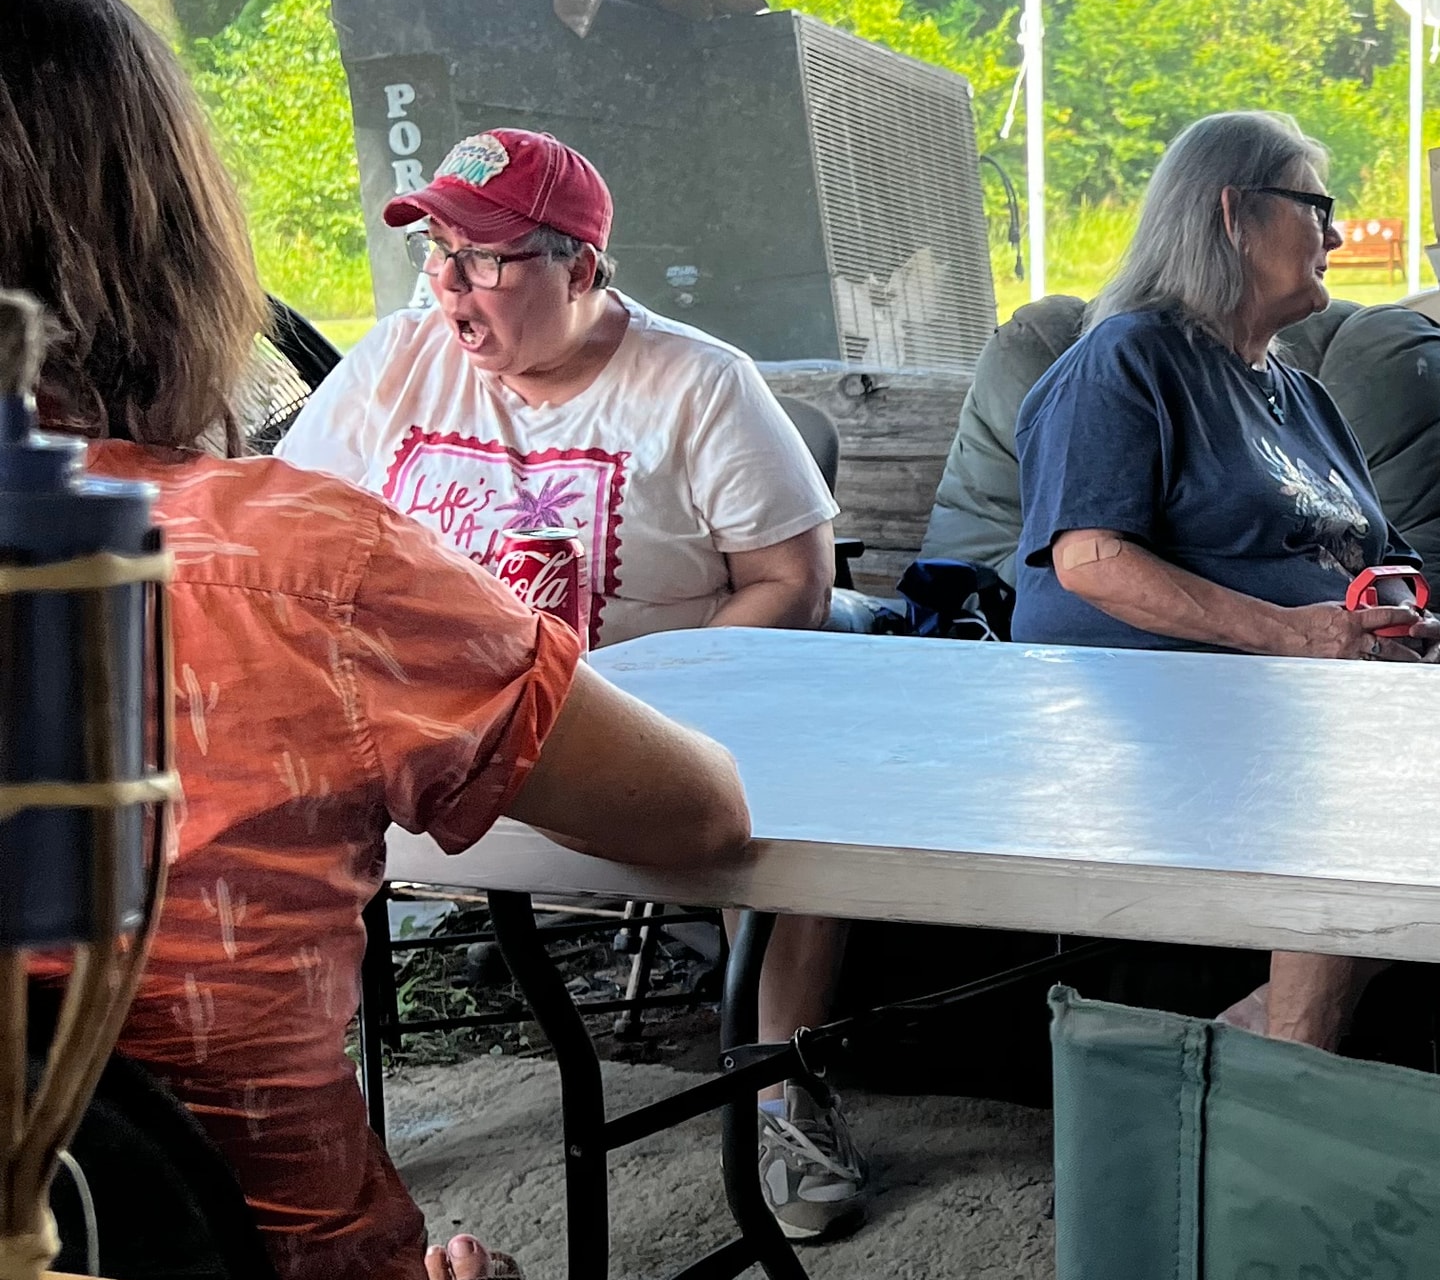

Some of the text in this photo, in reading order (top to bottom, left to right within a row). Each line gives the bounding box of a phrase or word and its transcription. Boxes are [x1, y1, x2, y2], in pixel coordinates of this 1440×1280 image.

[384, 83, 431, 234] POR
[405, 473, 497, 534] Life's
[454, 513, 484, 550] A
